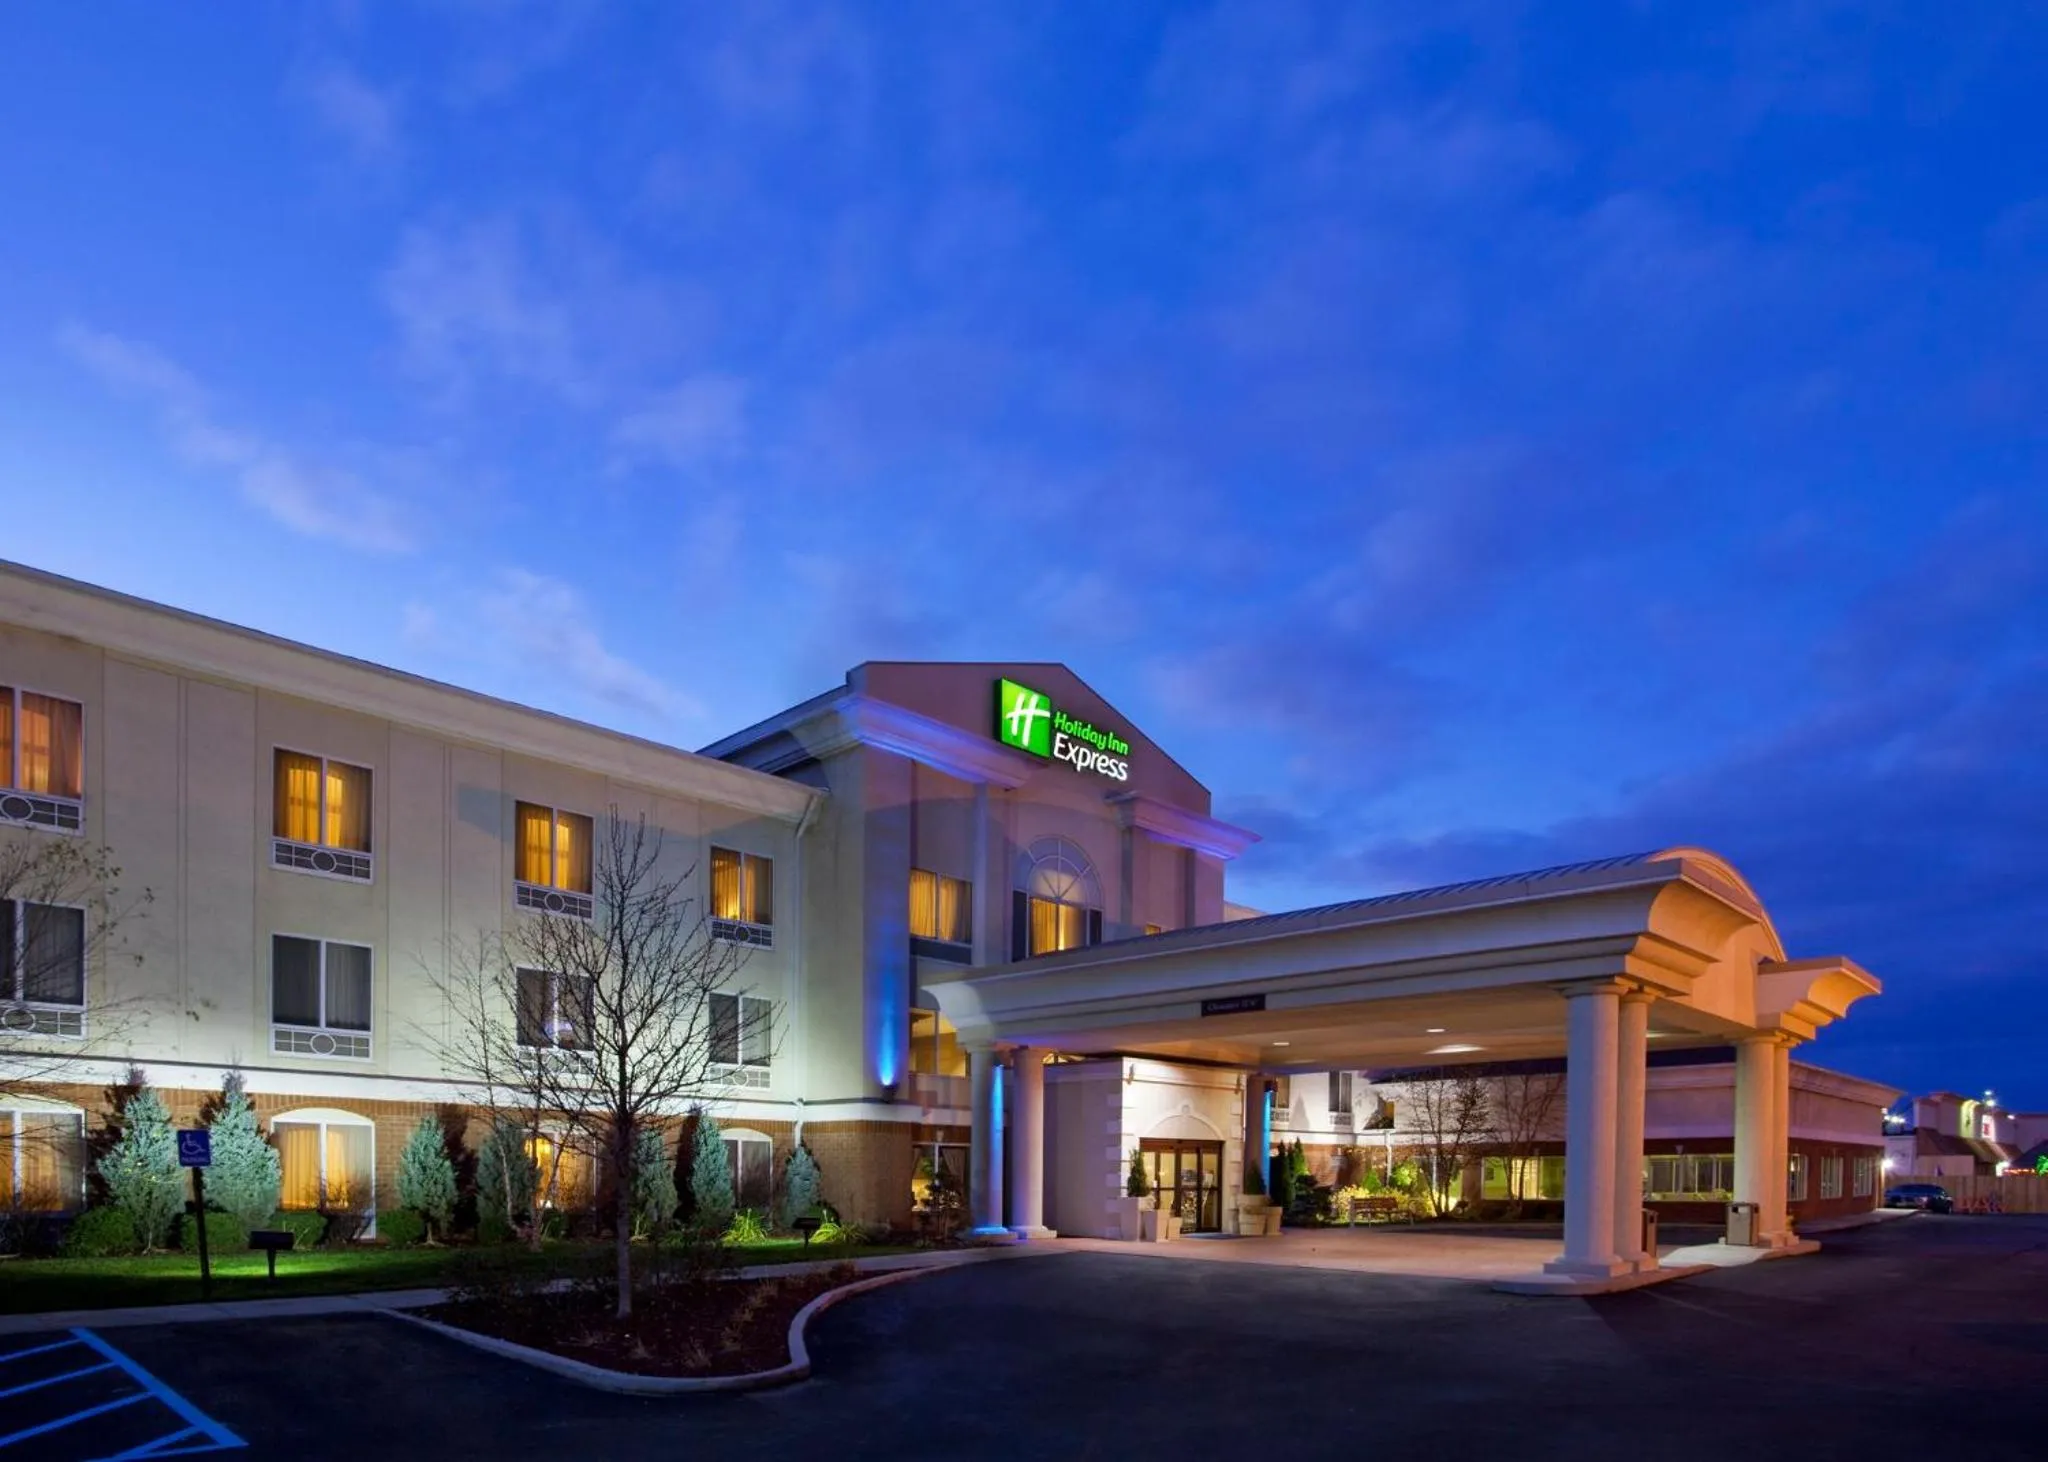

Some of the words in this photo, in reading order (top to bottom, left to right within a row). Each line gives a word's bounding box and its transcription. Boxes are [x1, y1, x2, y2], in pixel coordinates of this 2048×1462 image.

[1054, 711, 1106, 750] Holiday
[1108, 732, 1129, 756] Inn
[1053, 733, 1128, 781] Express
